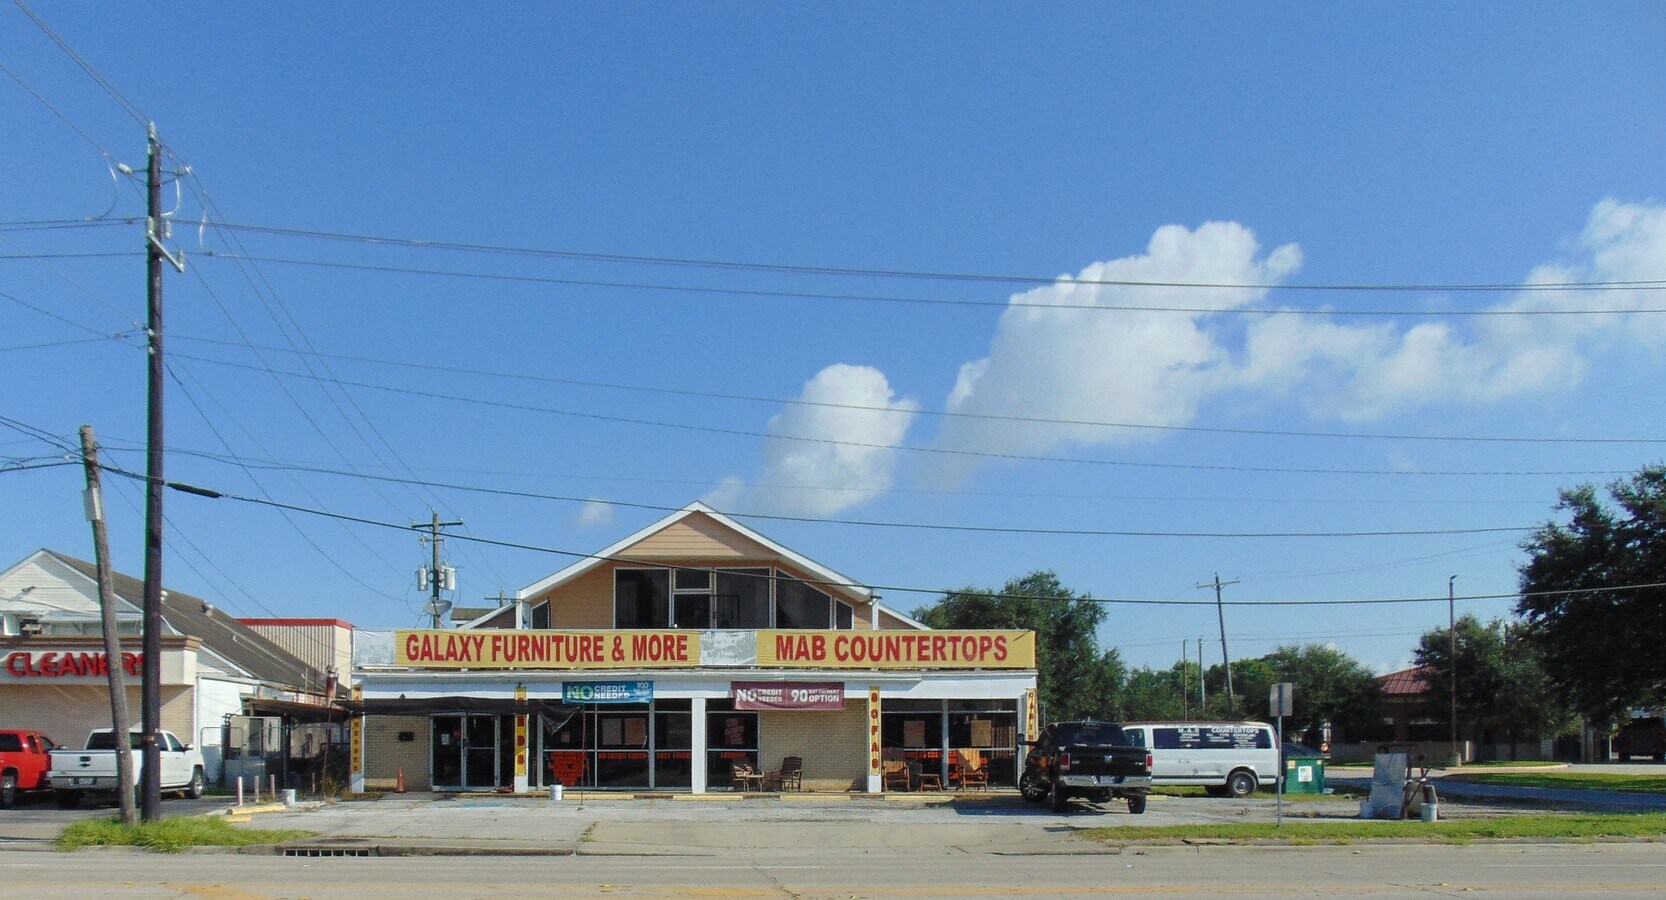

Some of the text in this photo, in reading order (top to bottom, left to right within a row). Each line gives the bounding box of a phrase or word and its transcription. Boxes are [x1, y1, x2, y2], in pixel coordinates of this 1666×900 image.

[406, 634, 688, 662] GALAXY FURNITURE & MORE
[776, 634, 1007, 662] MAB COUNTERTOPS
[566, 685, 594, 700] NO
[736, 688, 757, 702] NO
[791, 689, 808, 702] 90
[353, 687, 362, 771] MARESSES
[871, 692, 880, 769] SOFAS
